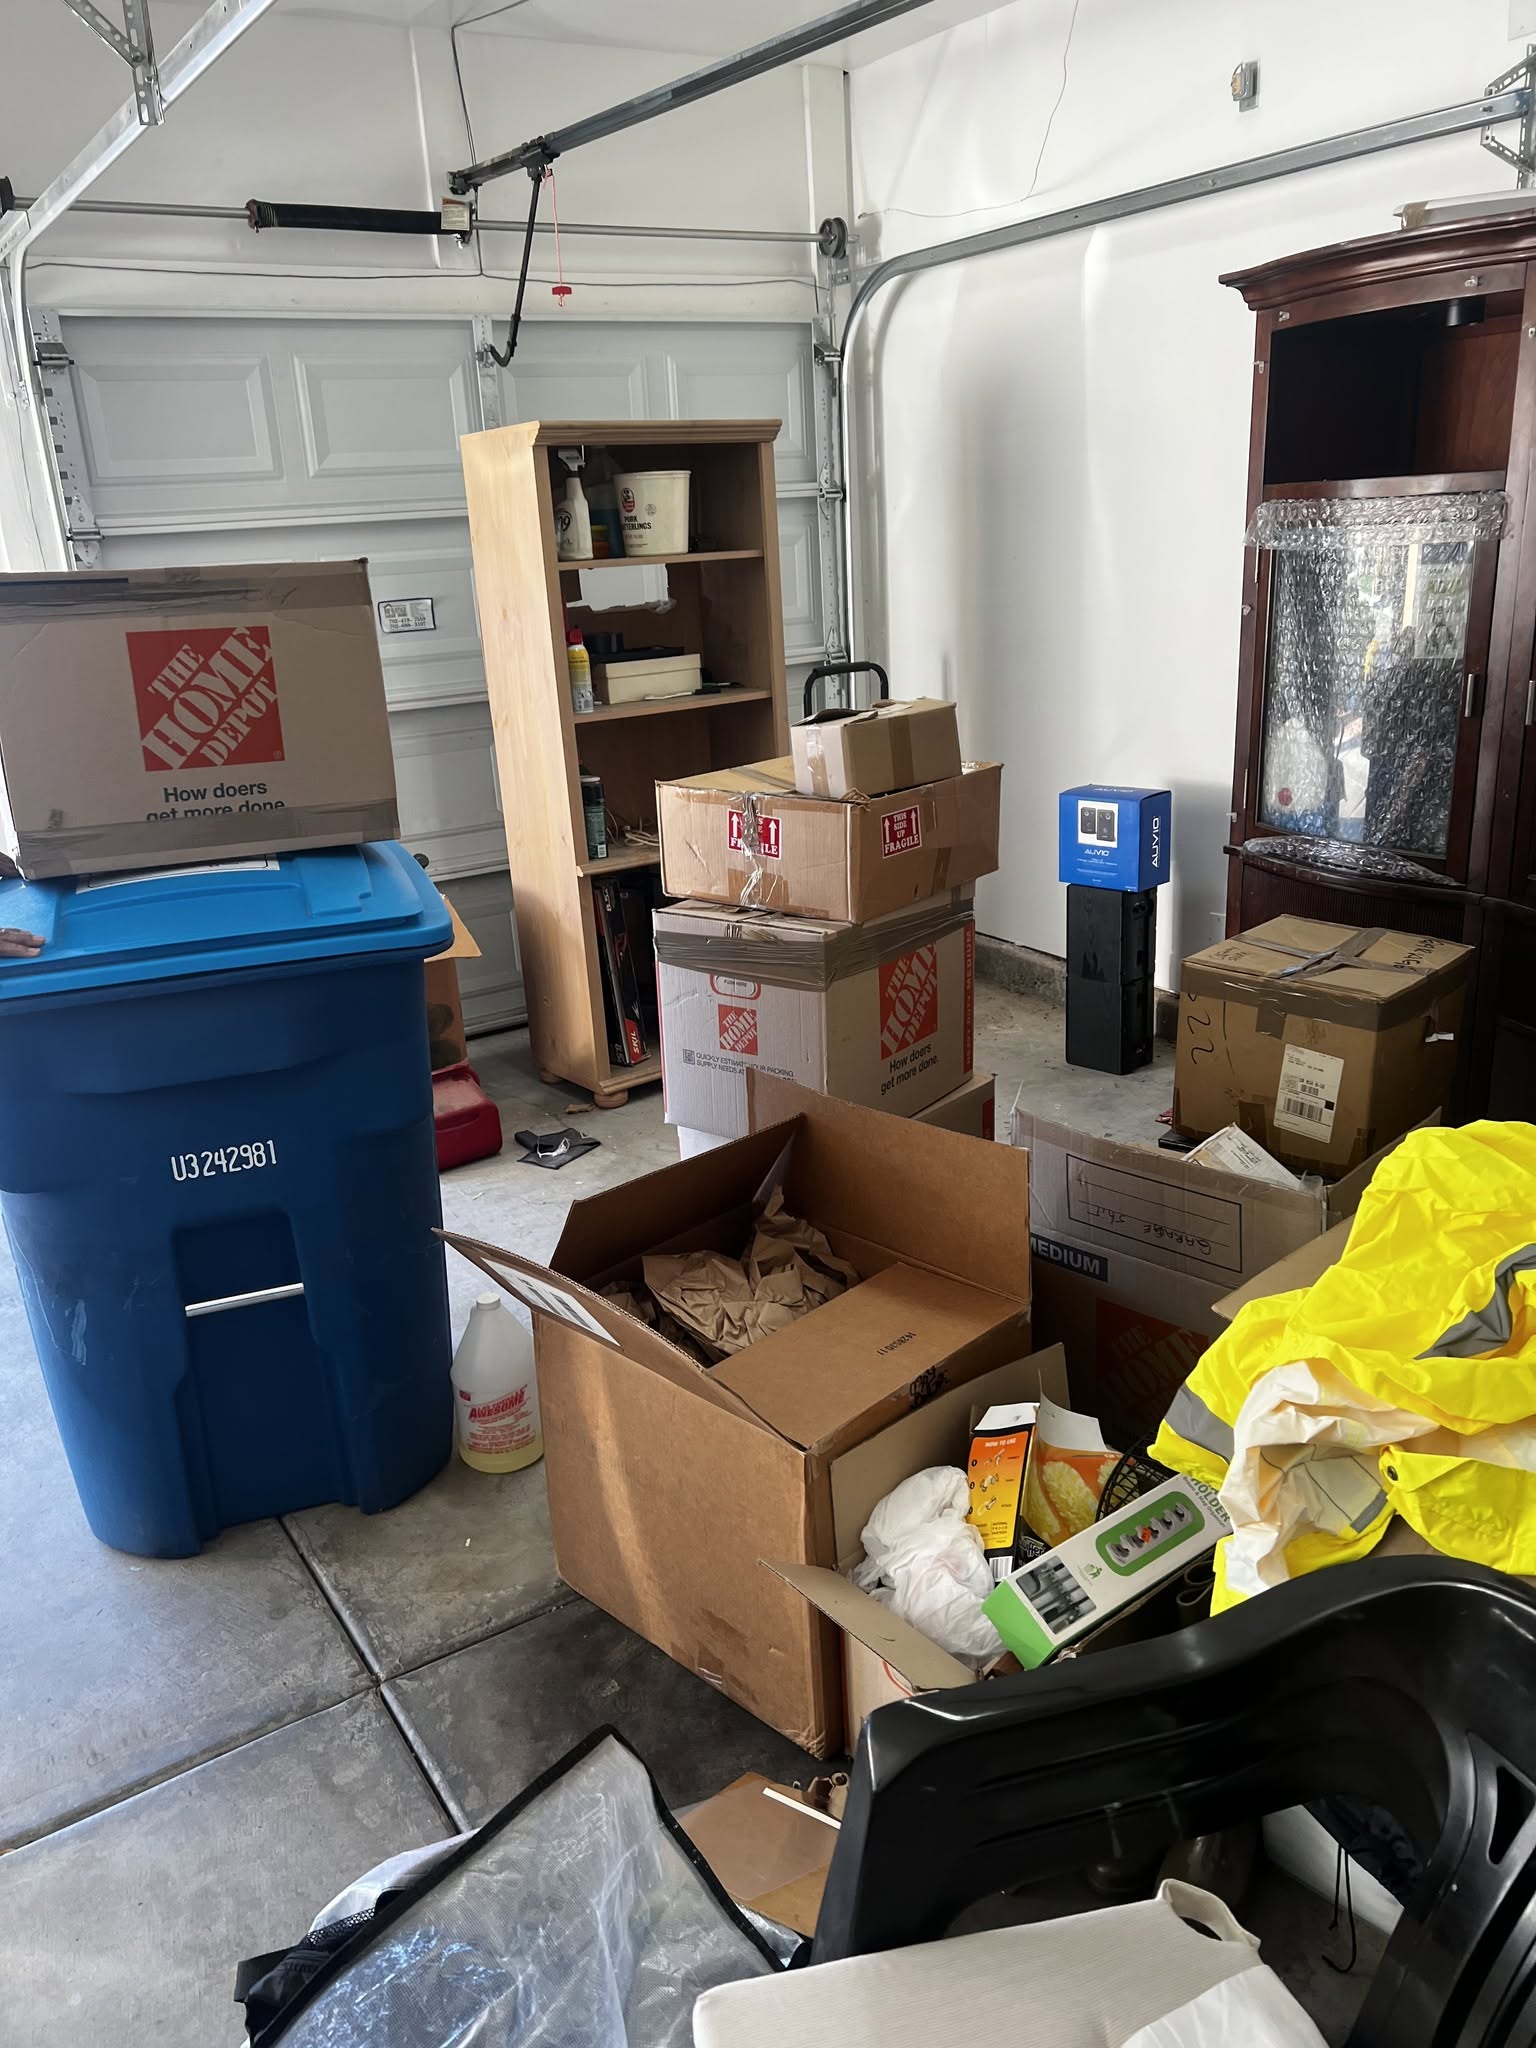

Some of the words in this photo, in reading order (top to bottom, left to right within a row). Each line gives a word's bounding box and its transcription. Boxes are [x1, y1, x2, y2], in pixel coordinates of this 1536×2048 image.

[147, 643, 204, 701] THE
[141, 626, 272, 770] HOME
[200, 677, 278, 767] DEPOT
[163, 787, 207, 803] How
[213, 782, 268, 799] doers
[893, 812, 907, 822] THIS
[894, 820, 907, 831] SIDE
[884, 834, 920, 854] FRAGILE
[896, 829, 906, 839] UP
[1151, 815, 1160, 868] AUVIO
[1084, 848, 1110, 857] AUVIO
[886, 956, 910, 1001] THE
[881, 943, 937, 1053] HOME
[904, 968, 937, 1045] DEPOT
[720, 1008, 758, 1051] HOME
[722, 1010, 739, 1028] THE
[630, 1030, 640, 1055] SKIL
[734, 1027, 758, 1053] DEPOT
[695, 1052, 720, 1063] QUICKLY
[696, 1060, 718, 1070] SUPPLY
[718, 1064, 738, 1074] NEEDS
[889, 1055, 909, 1073] How
[909, 1043, 932, 1062] doers
[881, 1077, 895, 1096] get
[896, 1066, 917, 1085] more
[170, 1139, 277, 1181] U3242981
[1006, 1437, 1017, 1445] USE
